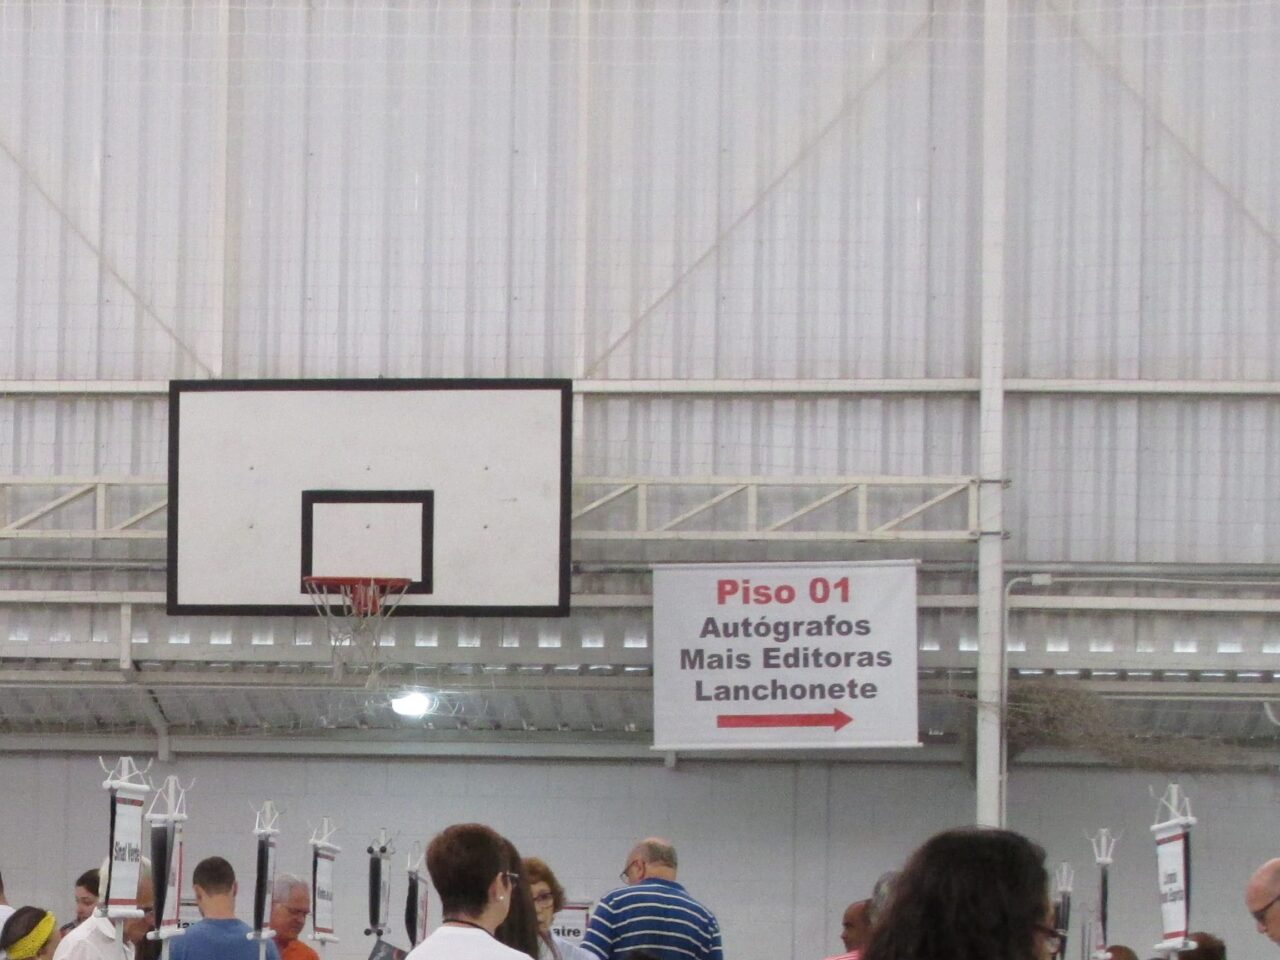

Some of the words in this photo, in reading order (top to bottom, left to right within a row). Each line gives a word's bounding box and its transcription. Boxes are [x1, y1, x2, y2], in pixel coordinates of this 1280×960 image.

[717, 579, 796, 605] Piso
[809, 577, 850, 604] 01
[700, 615, 871, 642] Autógrafos
[680, 648, 752, 670] Mais
[763, 646, 893, 670] Editoras
[695, 679, 878, 702] Lanchonete
